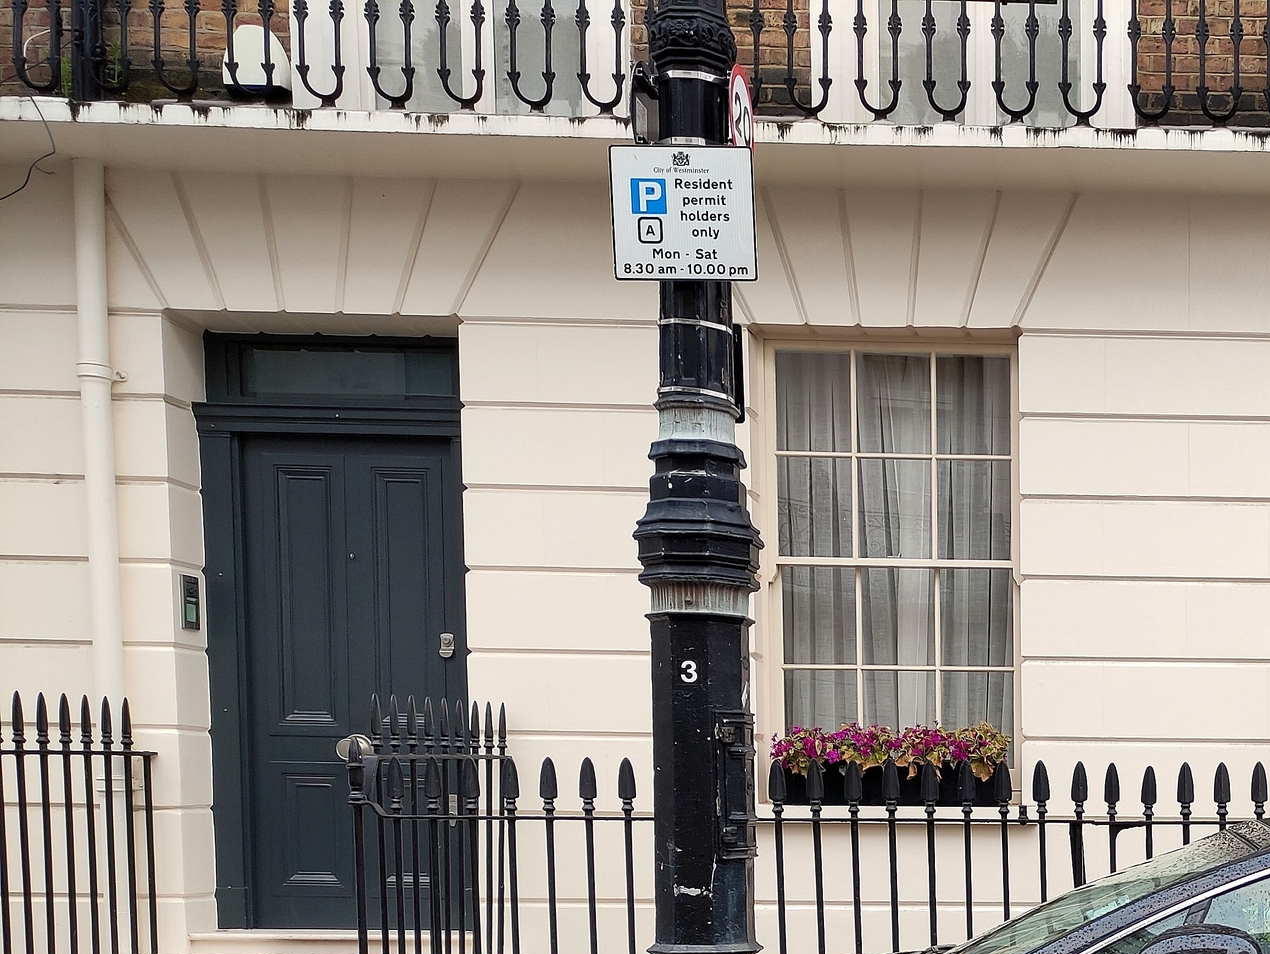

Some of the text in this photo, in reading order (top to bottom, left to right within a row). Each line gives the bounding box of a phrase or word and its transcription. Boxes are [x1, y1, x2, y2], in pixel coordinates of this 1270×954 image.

[735, 91, 751, 147] 20
[653, 166, 710, 175] City of Westminster
[674, 178, 733, 190] Resident
[638, 181, 662, 212] P
[682, 194, 727, 206] permit
[680, 210, 730, 222] holders
[645, 224, 656, 236] A
[691, 226, 720, 240] only
[652, 248, 681, 260] Mon
[695, 248, 718, 260] Sat
[623, 263, 655, 275] 8.30
[657, 265, 677, 275] am
[687, 264, 726, 275] 10.00
[728, 266, 749, 277] pm
[680, 660, 698, 683] 3
